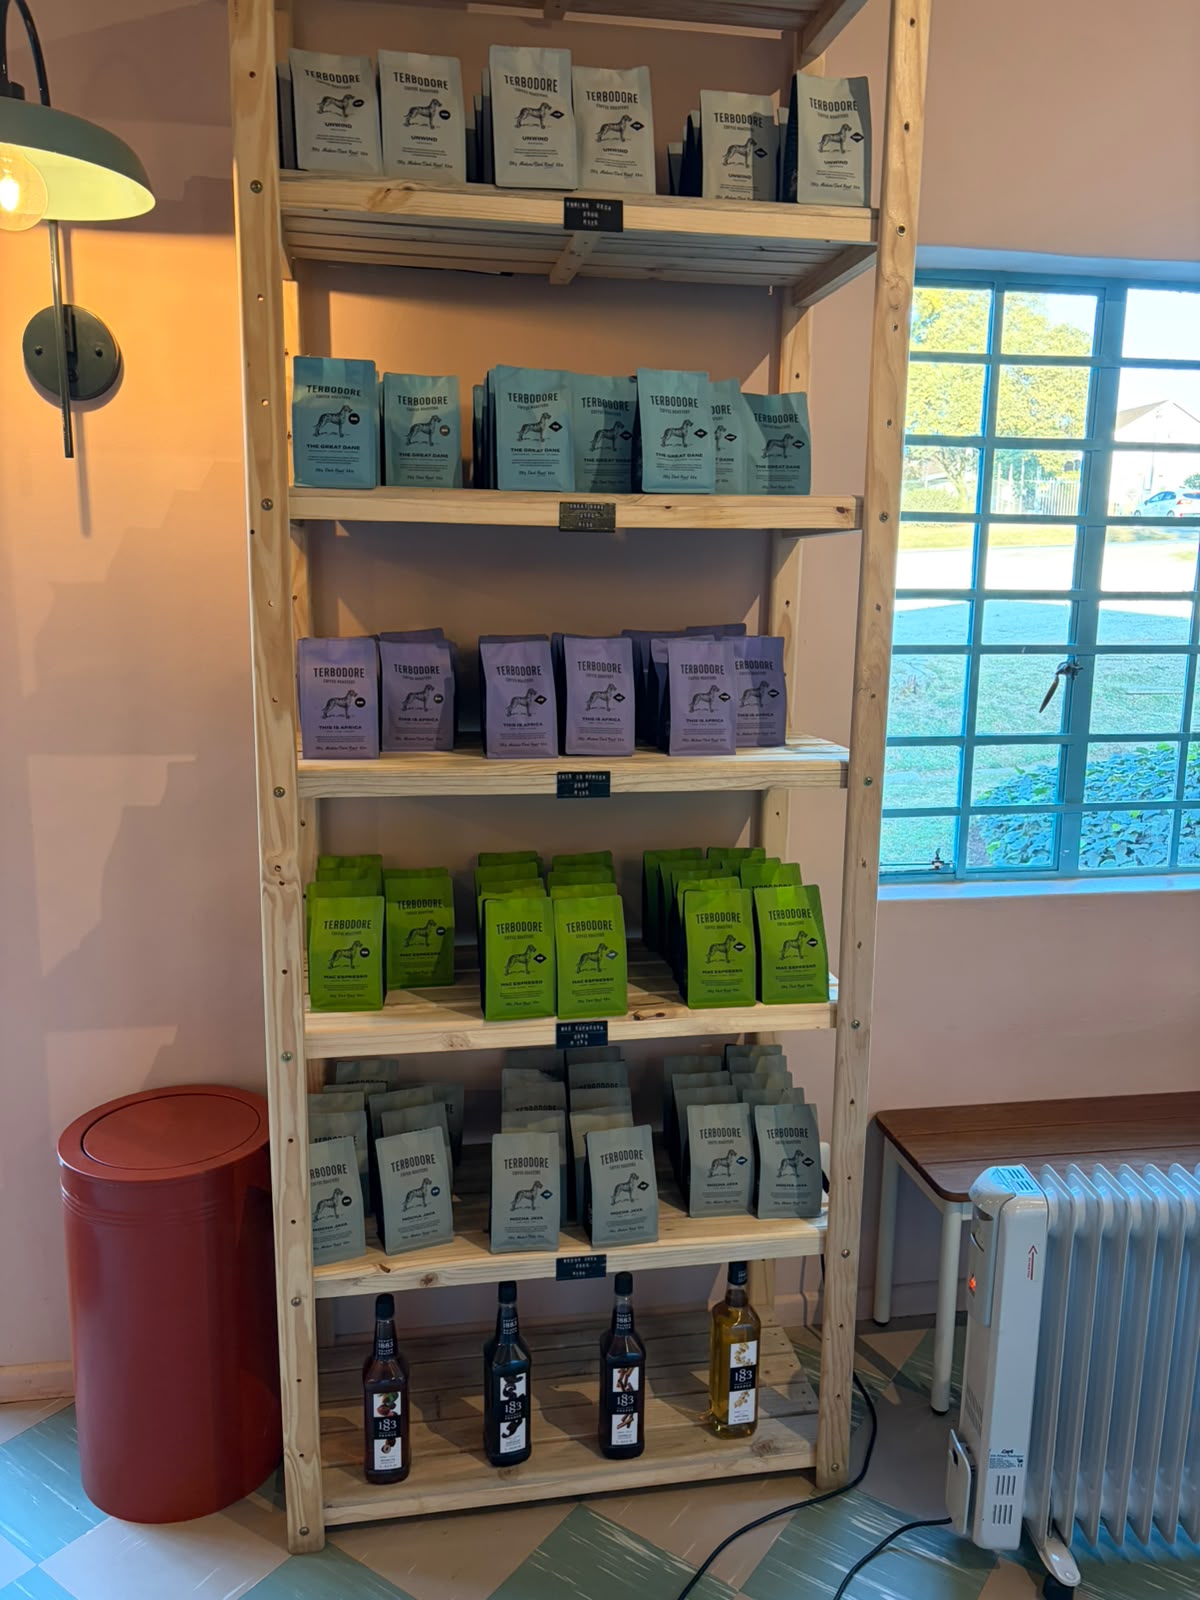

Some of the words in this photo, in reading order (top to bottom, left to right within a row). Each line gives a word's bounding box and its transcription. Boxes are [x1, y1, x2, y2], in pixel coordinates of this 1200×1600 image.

[304, 69, 362, 84] TERBODORE
[392, 71, 450, 91] TERBODORE
[504, 74, 558, 94] TERBODORE
[586, 90, 639, 104] TERBODORE
[808, 97, 858, 112] TERBODORE
[714, 112, 764, 128] TERBODORE
[306, 384, 361, 398] TERBODORE
[397, 394, 448, 406] TERBODORE
[508, 392, 558, 404] TERBODORE
[580, 397, 630, 412] TERBODORE
[650, 395, 700, 408] TERBODORE
[754, 412, 800, 424] TERBODORE
[313, 667, 365, 678] TERBODORE
[394, 663, 440, 675] TERBODORE
[496, 665, 542, 676] TERBODORE
[577, 660, 622, 674] TERBODORE
[680, 664, 725, 675] TERBODORE
[734, 660, 774, 672] ERBODORE
[397, 898, 443, 910] TERBODORE
[696, 912, 742, 924] TERBODORE
[768, 908, 812, 921] TERBODORE
[324, 919, 372, 930] TERBODORE
[496, 921, 544, 935] TERBODORE
[566, 920, 614, 933] TERBODORE
[699, 1128, 742, 1140] TERBODORE
[766, 1128, 809, 1140] TERBODORE
[390, 1154, 436, 1173] TERBODORE
[504, 1156, 550, 1170] TERBODORE
[600, 1149, 644, 1166] TERBODORE
[310, 1164, 348, 1179] RBODORE
[378, 1341, 394, 1350] 1883
